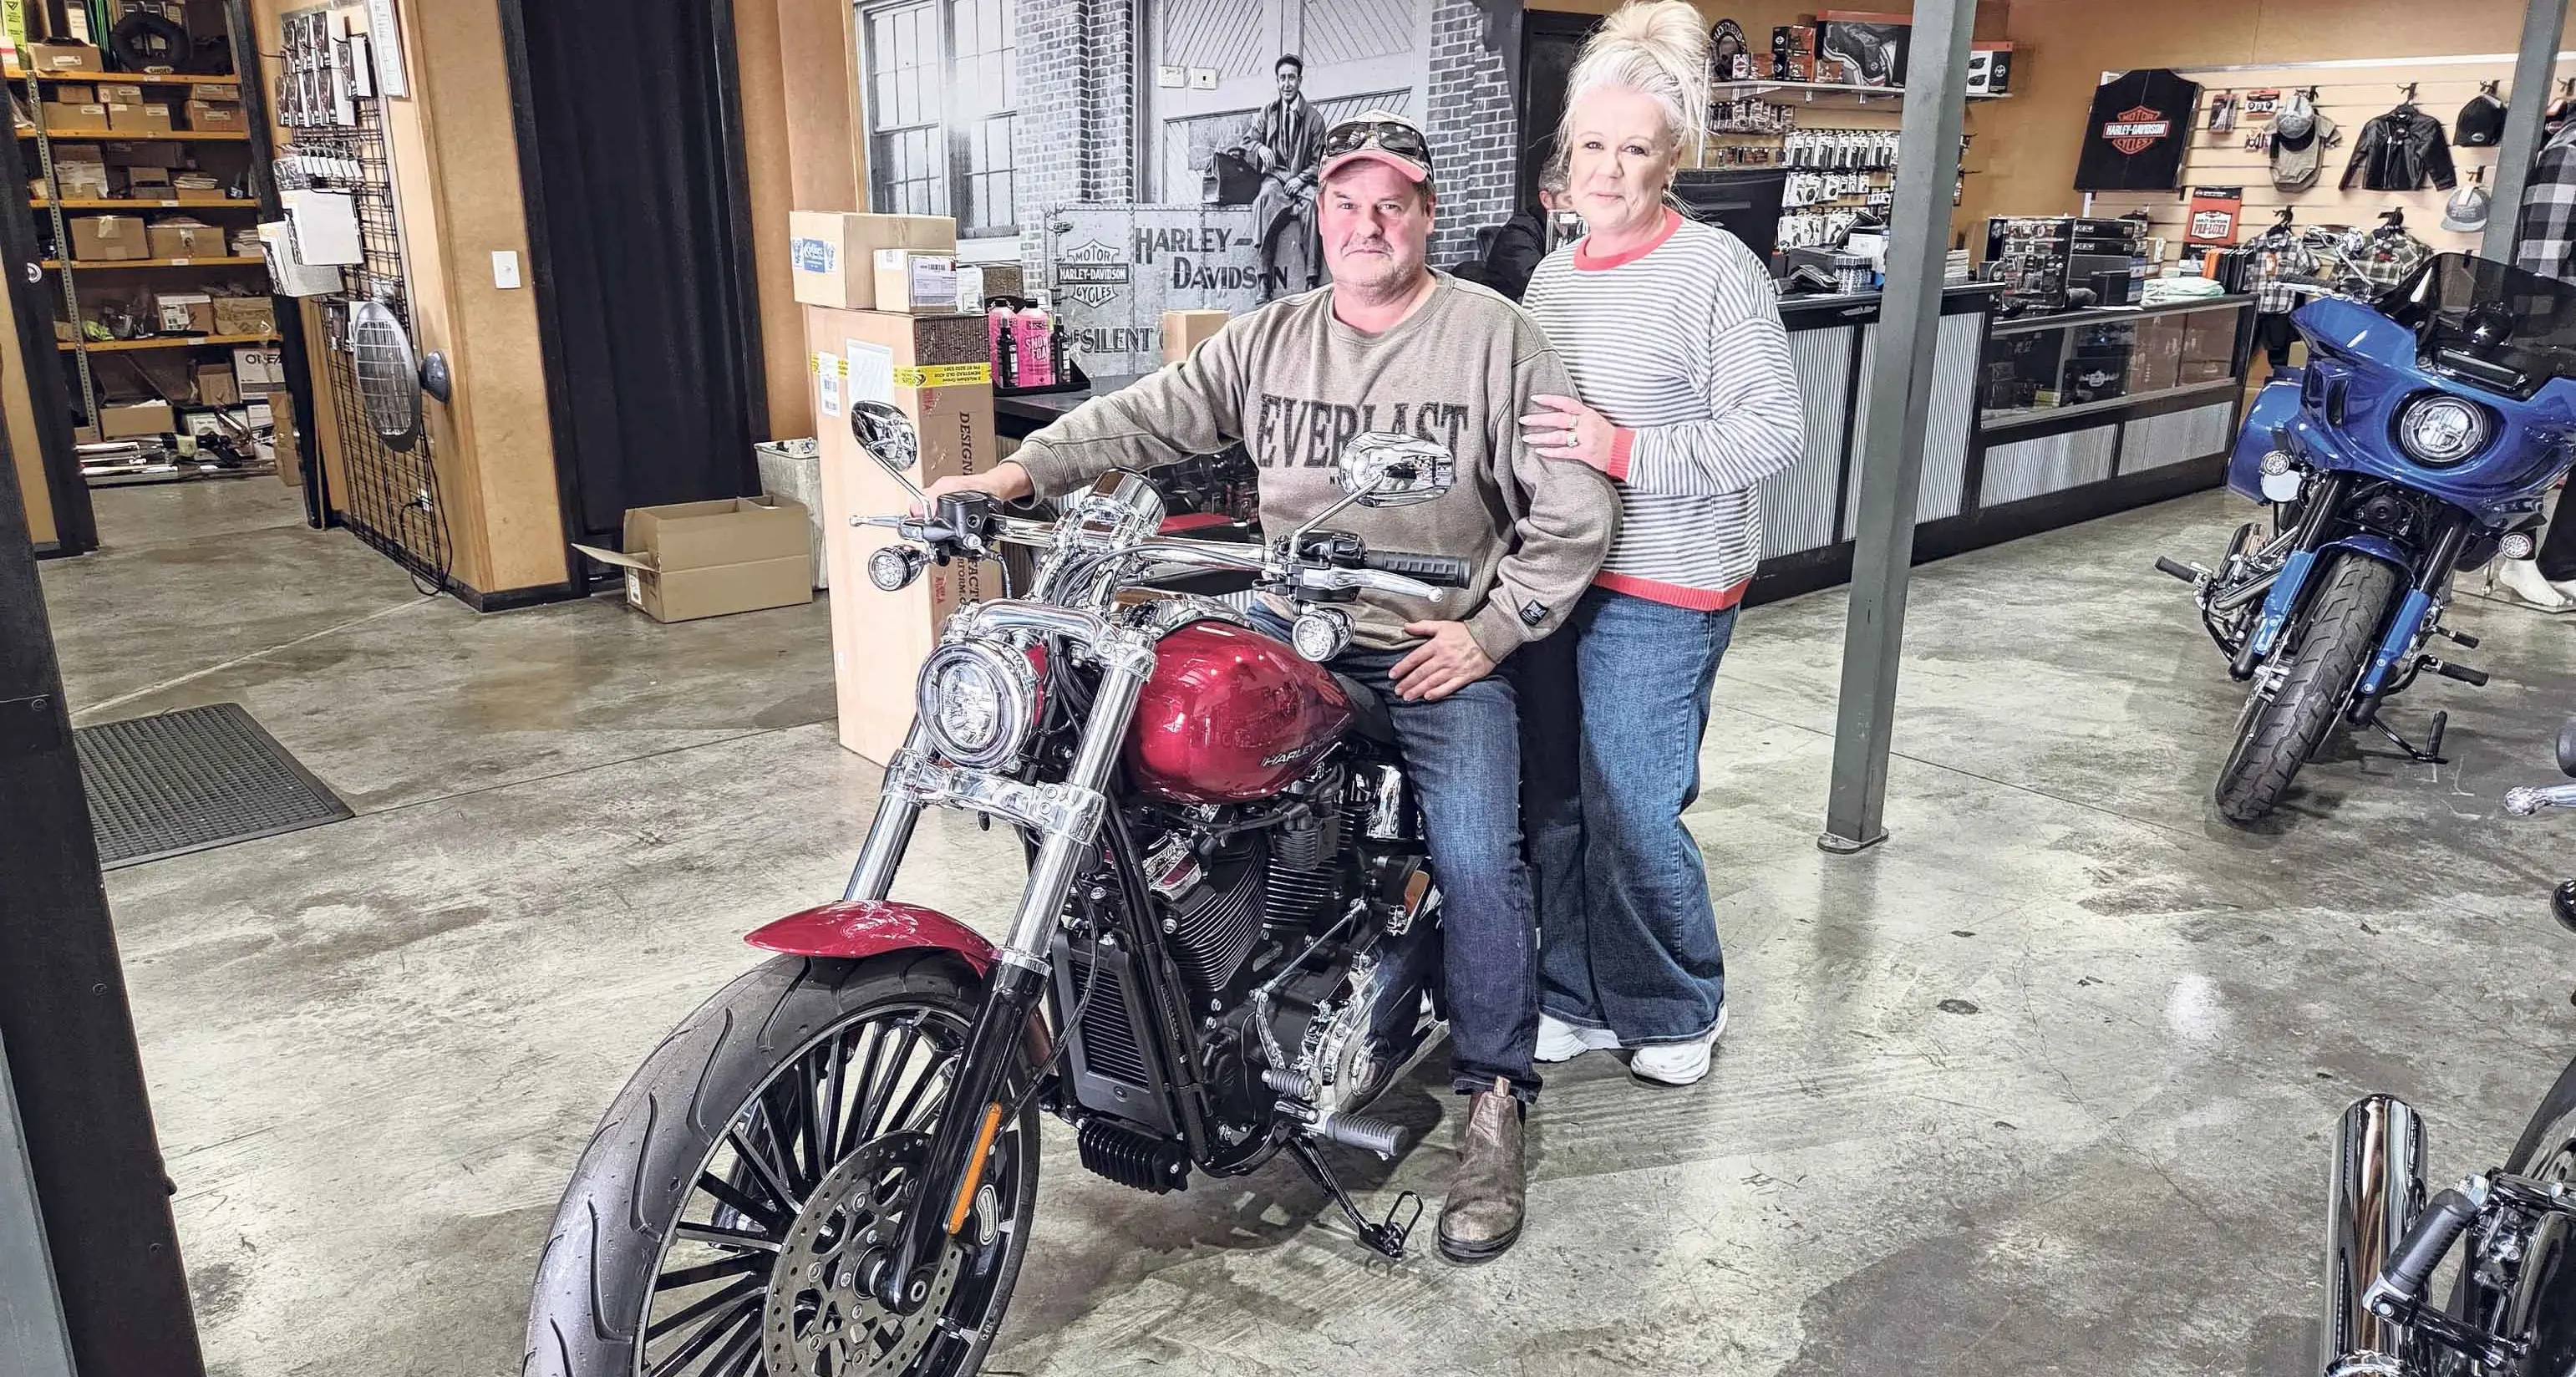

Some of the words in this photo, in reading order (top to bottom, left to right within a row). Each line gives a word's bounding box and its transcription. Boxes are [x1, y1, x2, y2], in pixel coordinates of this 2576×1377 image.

[2121, 109, 2154, 122] MOTOR
[2106, 124, 2166, 135] HARLEY-DAVIDSON
[2116, 138, 2148, 151] CYCLES
[1075, 244, 1110, 262] MOTOR
[1059, 267, 1126, 280] HARLEY-DAVIDSON
[1173, 257, 1288, 290] DAVIDSN
[1076, 287, 1111, 303] CYCLES
[1080, 327, 1154, 353] SILENT
